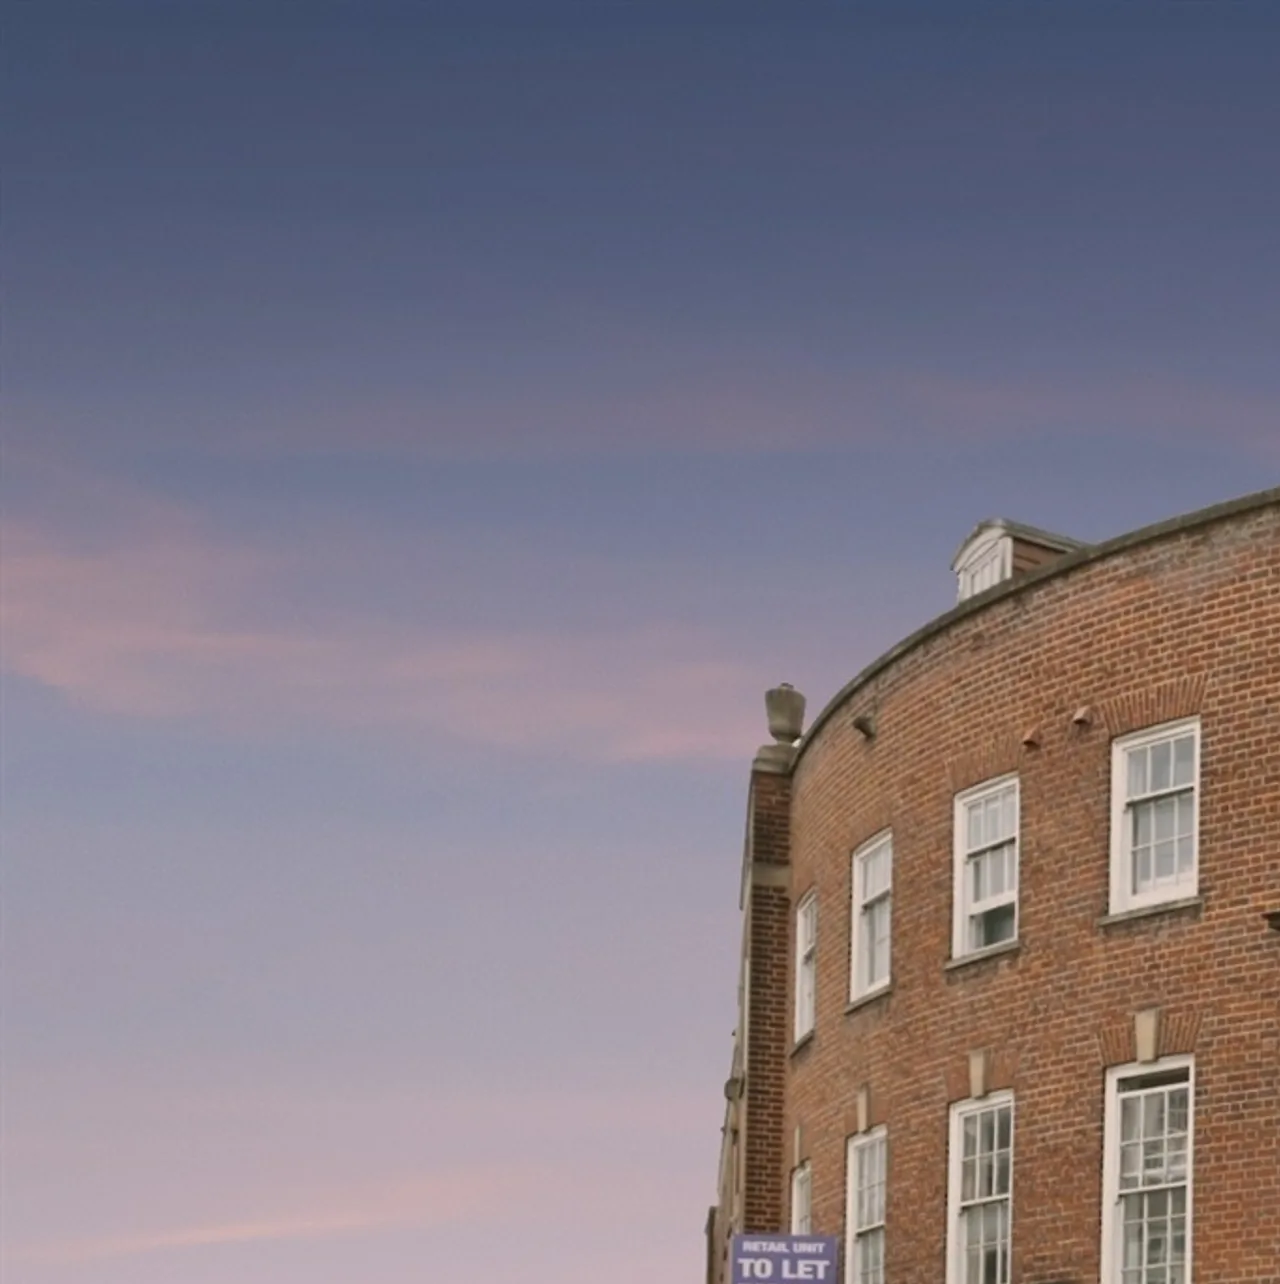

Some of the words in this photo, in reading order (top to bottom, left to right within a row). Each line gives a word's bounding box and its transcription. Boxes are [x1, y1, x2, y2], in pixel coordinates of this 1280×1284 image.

[742, 1241, 790, 1254] RETAIL
[792, 1242, 826, 1254] UNIT
[737, 1257, 774, 1279] TO
[781, 1258, 831, 1280] LET
